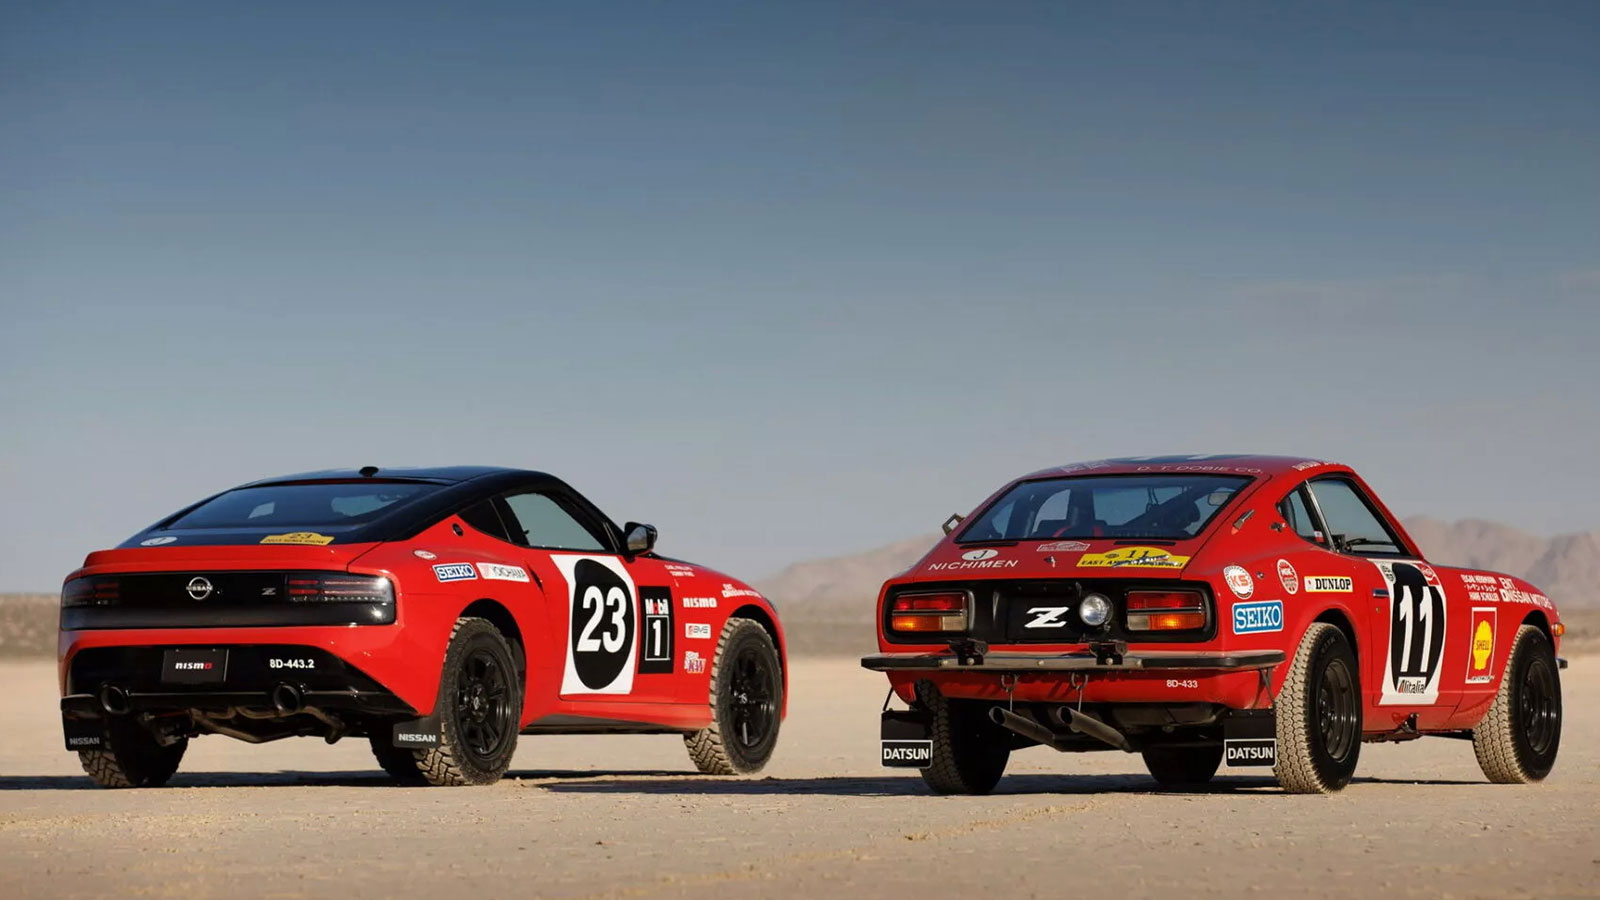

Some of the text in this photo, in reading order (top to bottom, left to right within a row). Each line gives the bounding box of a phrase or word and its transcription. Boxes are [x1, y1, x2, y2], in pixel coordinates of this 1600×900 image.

[973, 550, 988, 560] J
[1126, 550, 1150, 559] 11
[928, 560, 1019, 571] NICHIMEN
[435, 566, 475, 579] SEIKO
[1230, 575, 1249, 587] KS
[1315, 579, 1351, 590] DUNLOP
[576, 585, 627, 653] 23
[1024, 606, 1070, 629] Z
[1235, 605, 1281, 630] SEIKO
[1399, 585, 1433, 673] 11
[652, 619, 661, 656] 1
[269, 658, 315, 669] 8D-443.2
[1166, 680, 1198, 688] 8D-433
[1398, 680, 1426, 694] Alitalia
[69, 737, 100, 745] NISSAN
[398, 733, 437, 742] NISSAN
[883, 748, 929, 760] DATSUN
[1227, 747, 1274, 760] DATSUN
